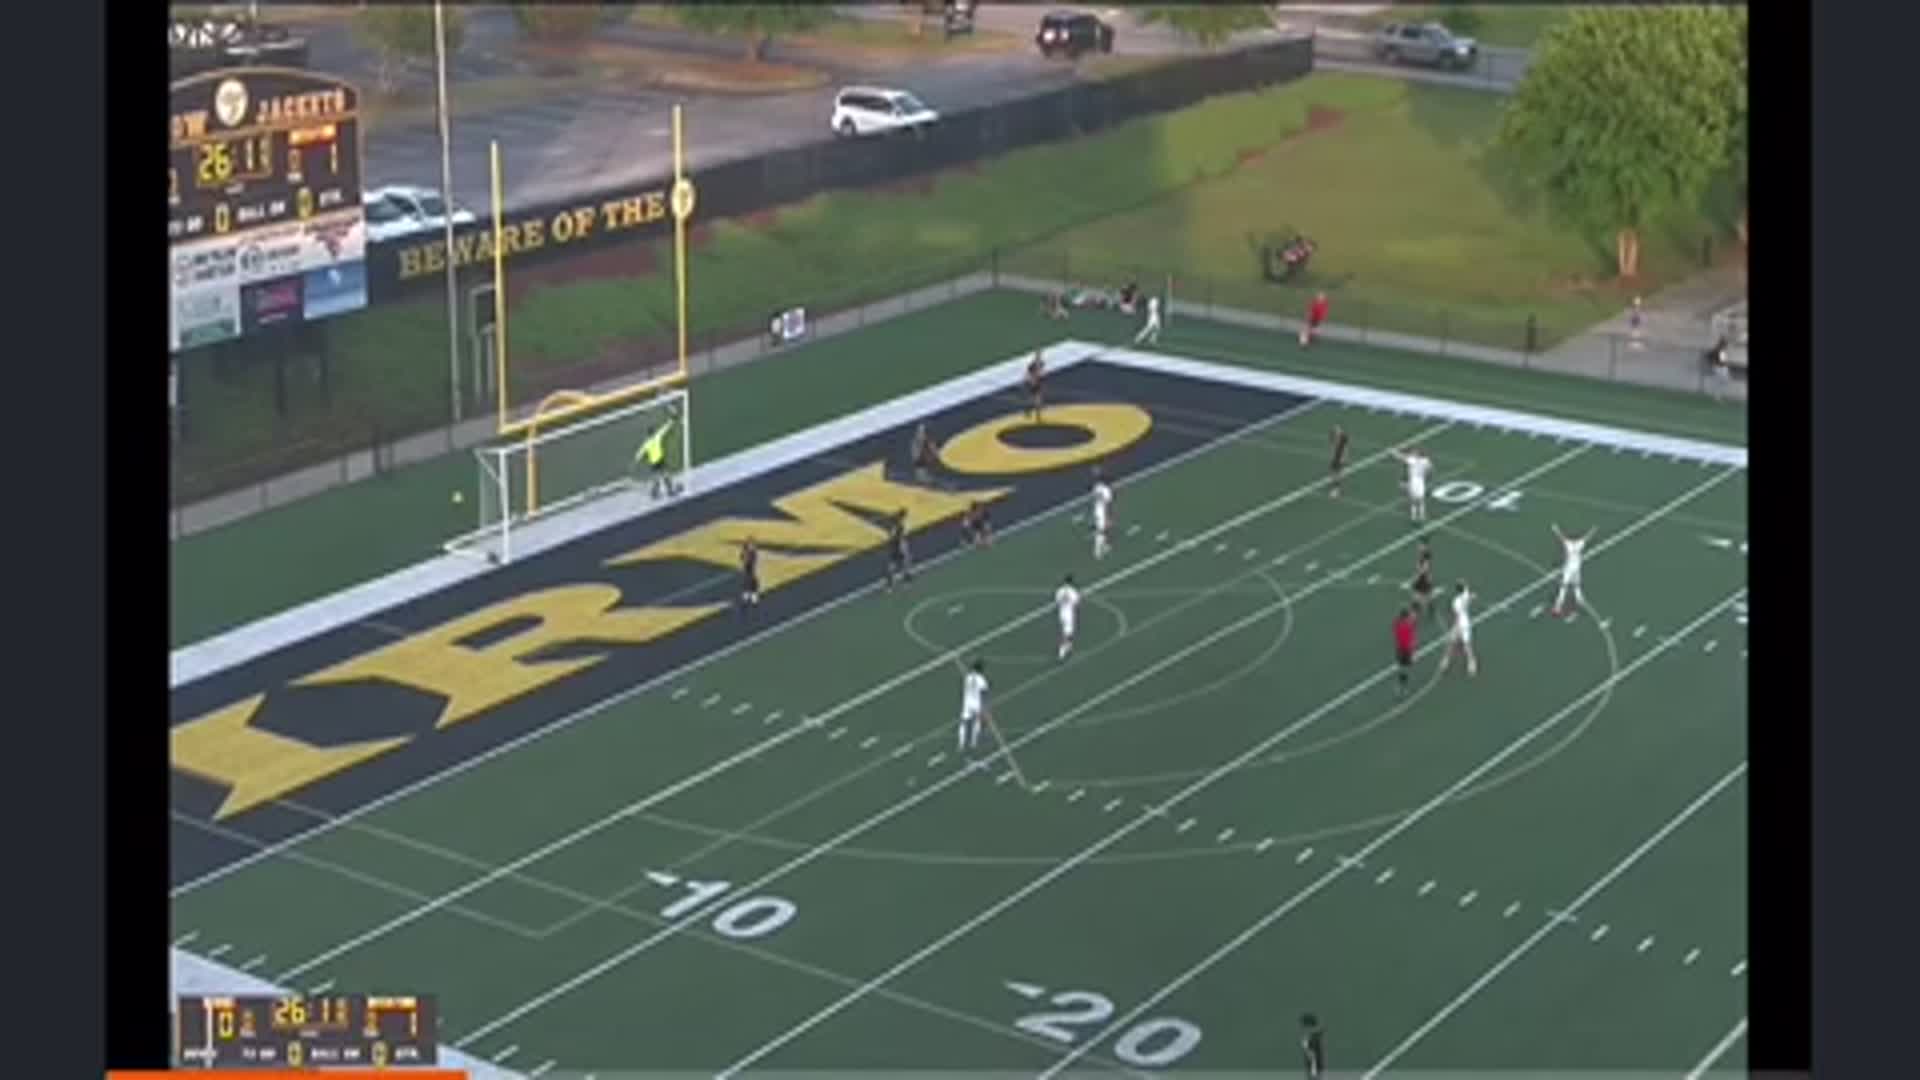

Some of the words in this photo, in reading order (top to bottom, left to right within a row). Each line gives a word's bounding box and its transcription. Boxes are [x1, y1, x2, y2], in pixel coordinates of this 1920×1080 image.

[215, 203, 230, 234] 0
[398, 219, 545, 278] BEWARE
[551, 206, 597, 242] OF
[602, 191, 666, 229] THE
[659, 880, 798, 938] 10
[1014, 990, 1202, 1066] 20
